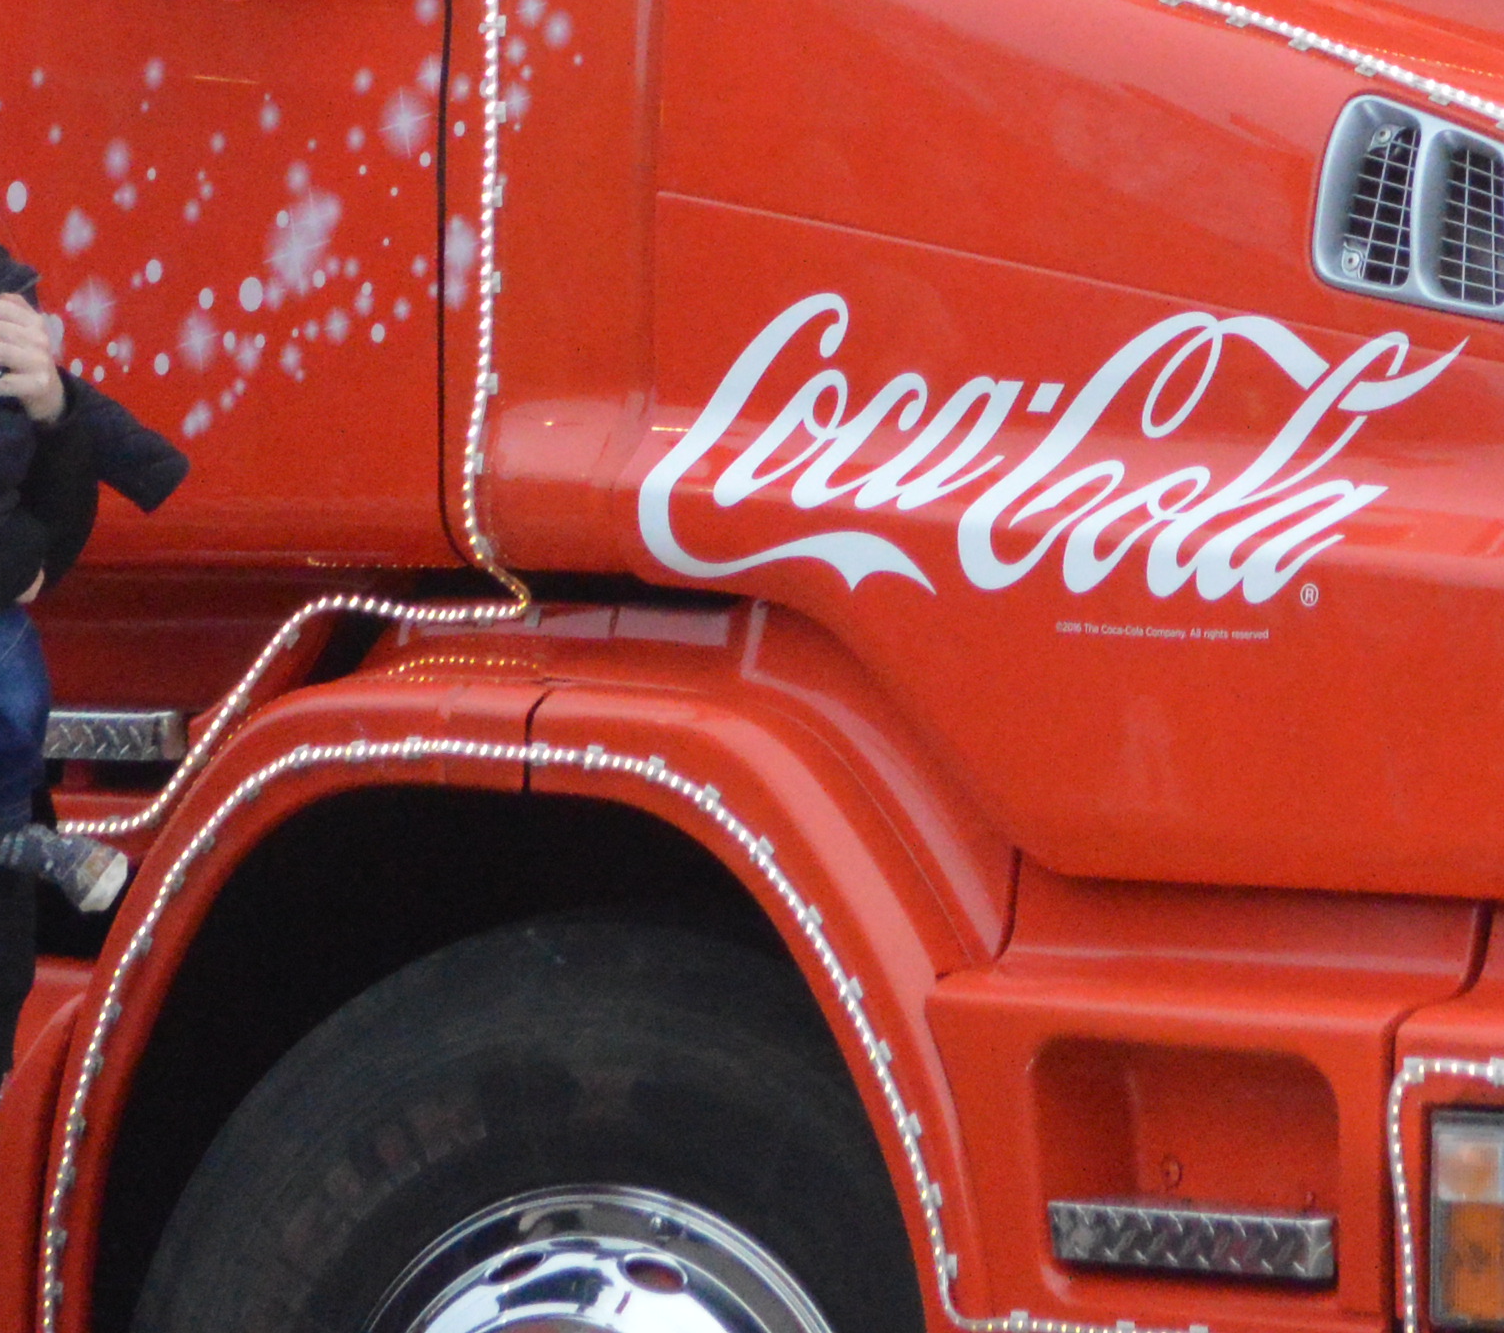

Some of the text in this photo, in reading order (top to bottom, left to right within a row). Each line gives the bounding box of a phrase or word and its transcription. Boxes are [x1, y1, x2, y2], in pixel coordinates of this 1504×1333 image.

[639, 293, 1466, 605] Coca-Cola
[1084, 623, 1099, 634] The
[1101, 624, 1144, 636] Coca-Cola
[1189, 627, 1202, 638] All
[1204, 629, 1228, 641] rights
[1232, 628, 1269, 640] reserved
